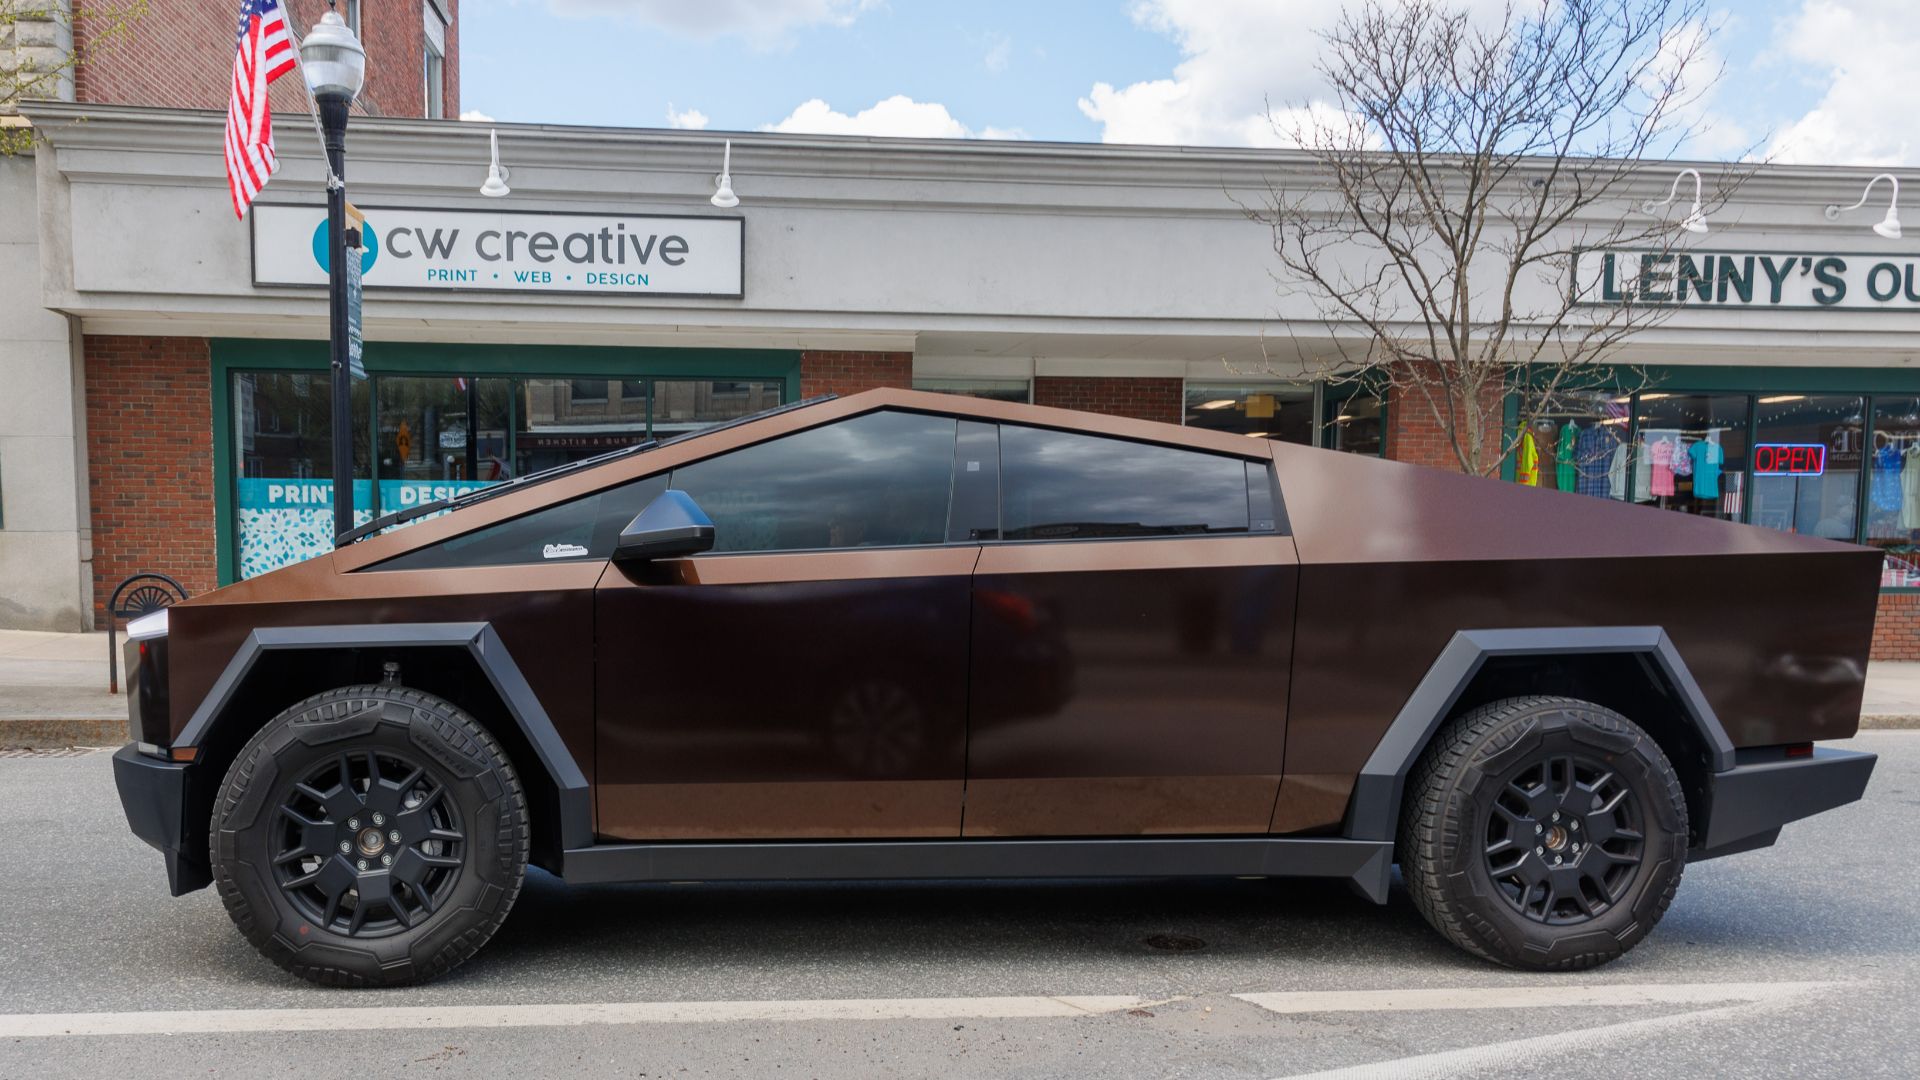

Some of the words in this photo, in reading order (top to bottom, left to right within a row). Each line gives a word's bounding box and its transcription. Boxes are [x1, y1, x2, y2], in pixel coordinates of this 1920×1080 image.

[475, 223, 690, 267] creative
[427, 268, 478, 282] PRINT
[514, 270, 551, 284] WEB
[586, 272, 650, 287] DESIGN
[1602, 253, 1847, 305] LENNY'S
[1755, 446, 1823, 473] OPEN
[400, 486, 481, 504] DESI
